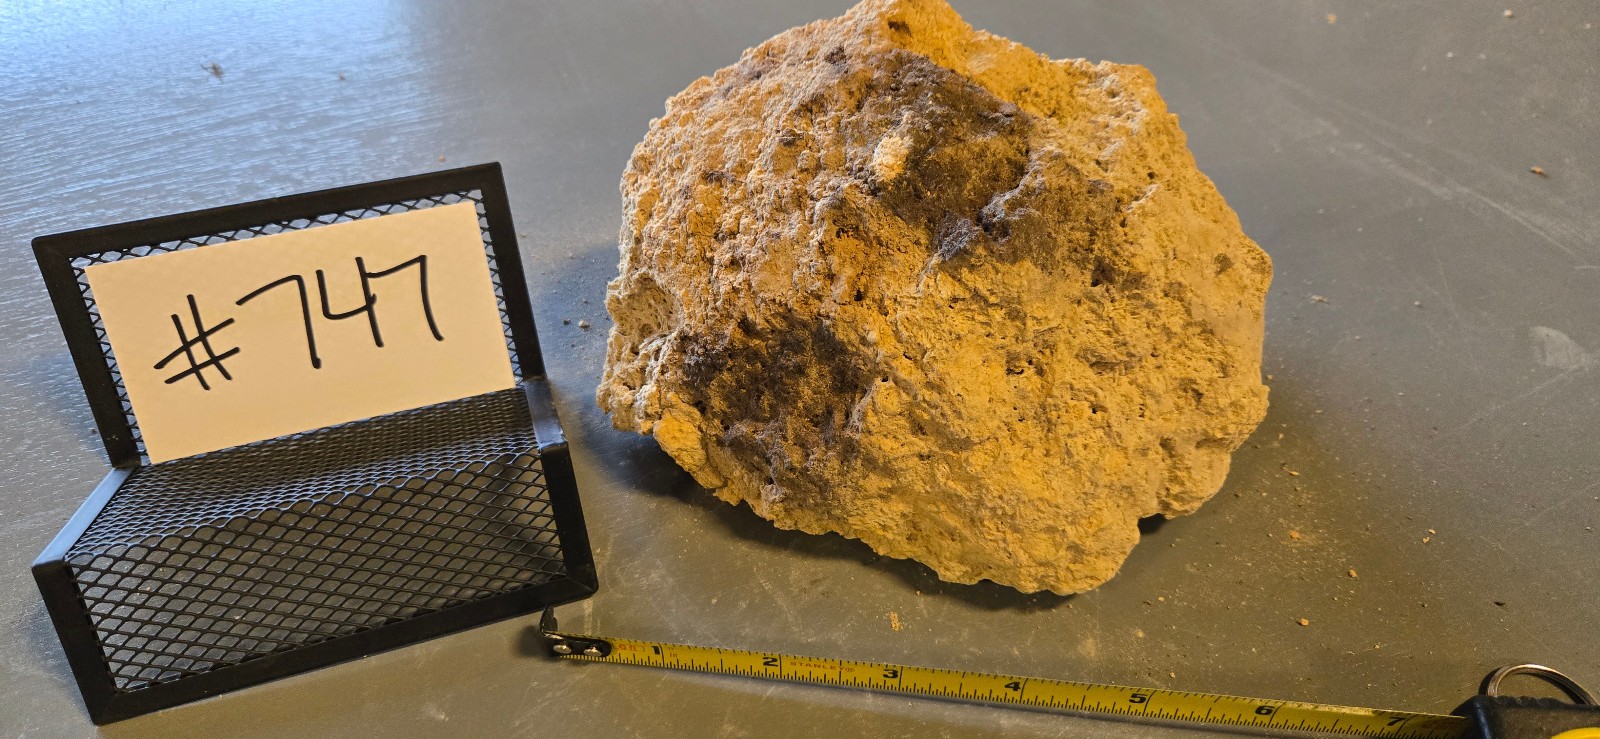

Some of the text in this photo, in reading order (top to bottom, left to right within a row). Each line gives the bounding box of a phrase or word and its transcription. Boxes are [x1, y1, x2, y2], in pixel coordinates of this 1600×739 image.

[153, 254, 445, 391] #747
[651, 645, 661, 655] 1
[762, 656, 779, 667] 2
[882, 668, 899, 679] 3
[1004, 681, 1021, 692] 4
[1128, 693, 1148, 704] 5
[1254, 705, 1276, 716] 6
[1386, 716, 1407, 727] 7
